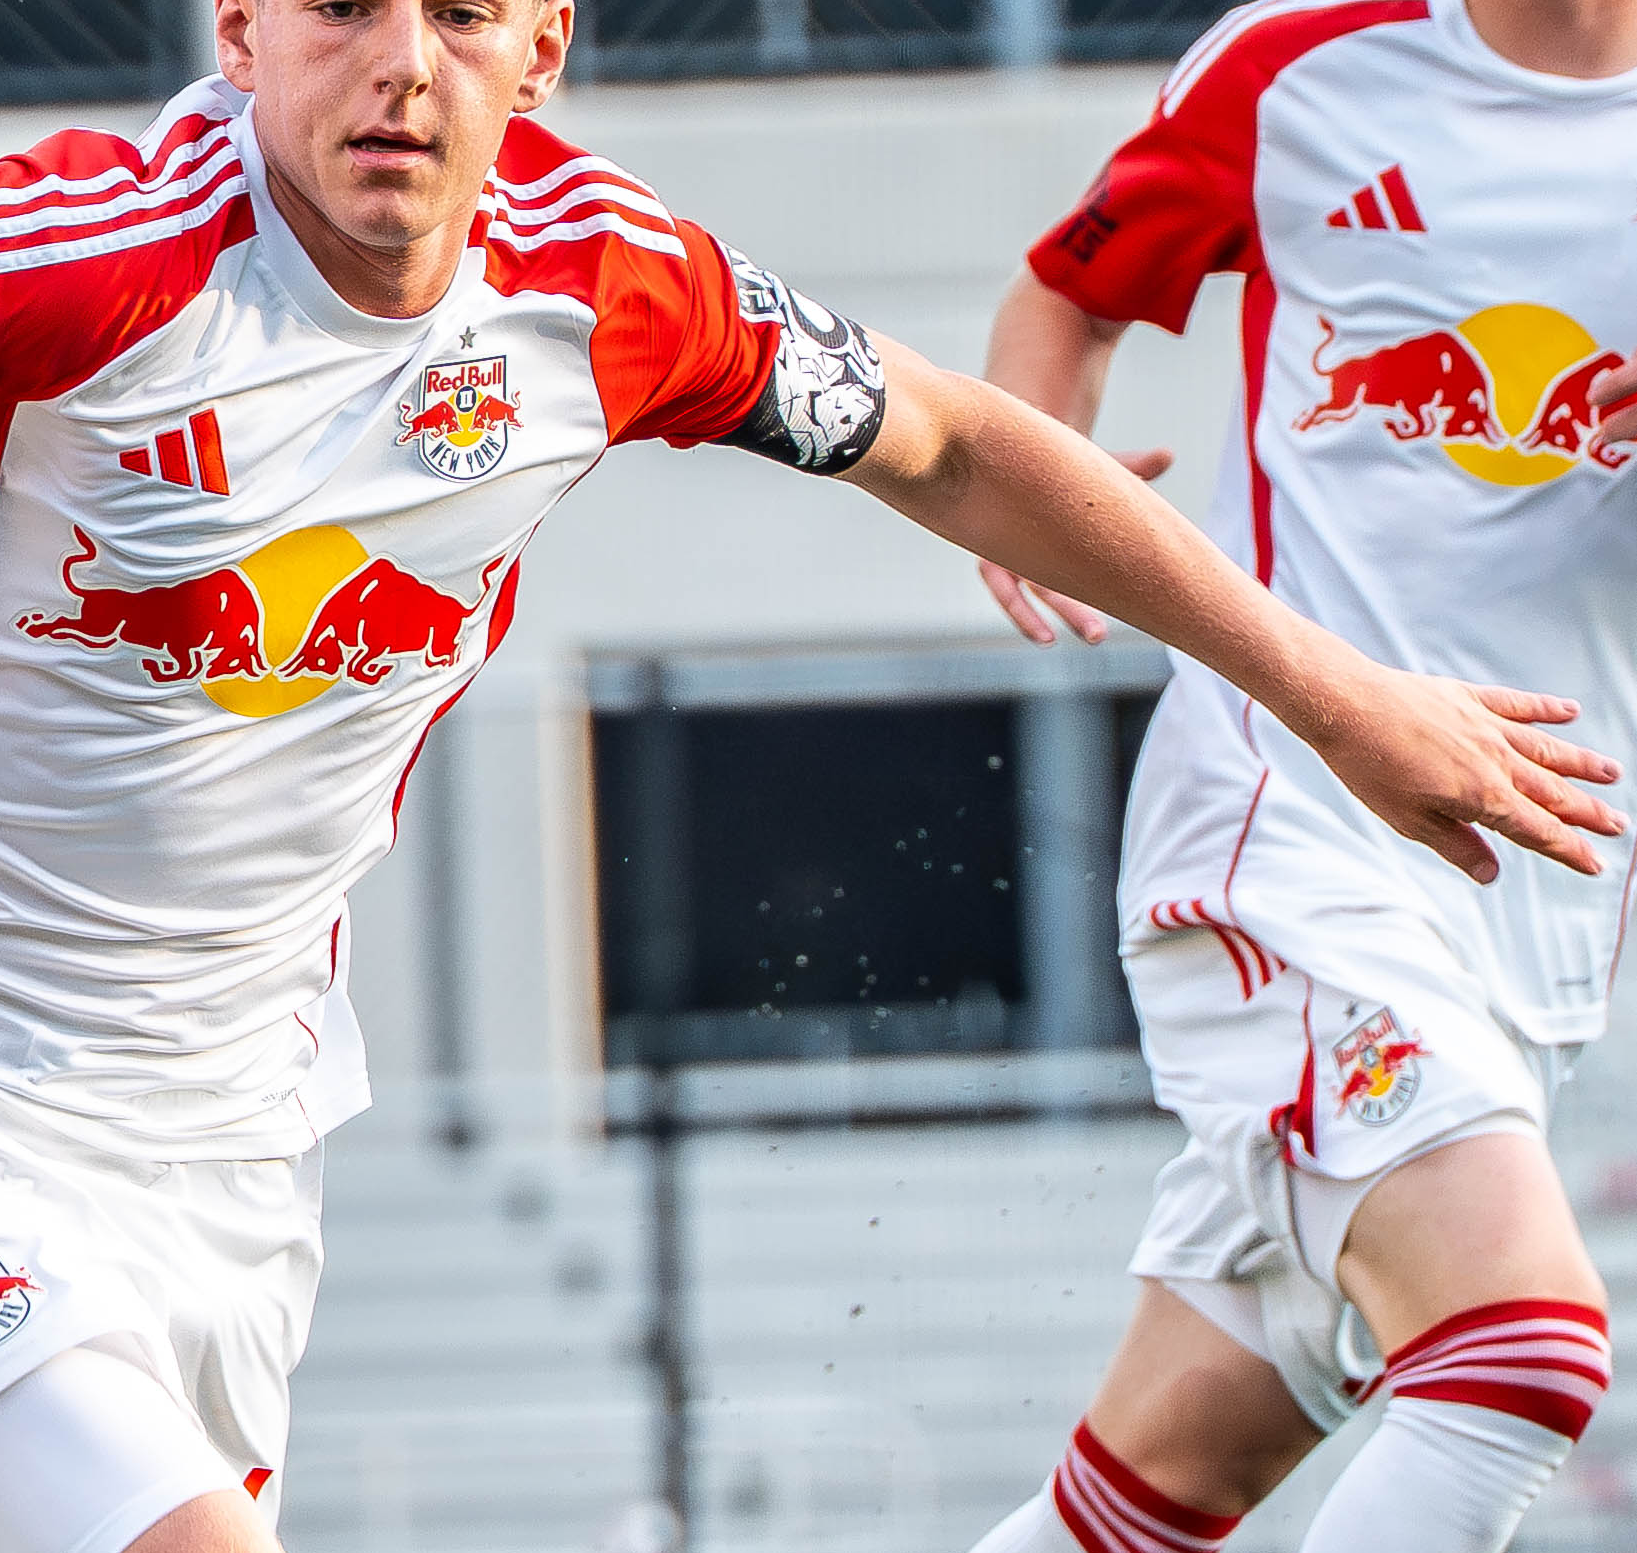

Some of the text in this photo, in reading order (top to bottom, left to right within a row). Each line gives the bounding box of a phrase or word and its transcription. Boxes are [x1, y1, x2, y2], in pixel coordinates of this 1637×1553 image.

[426, 361, 502, 393] Red Bull
[429, 435, 501, 473] NEW YORK
